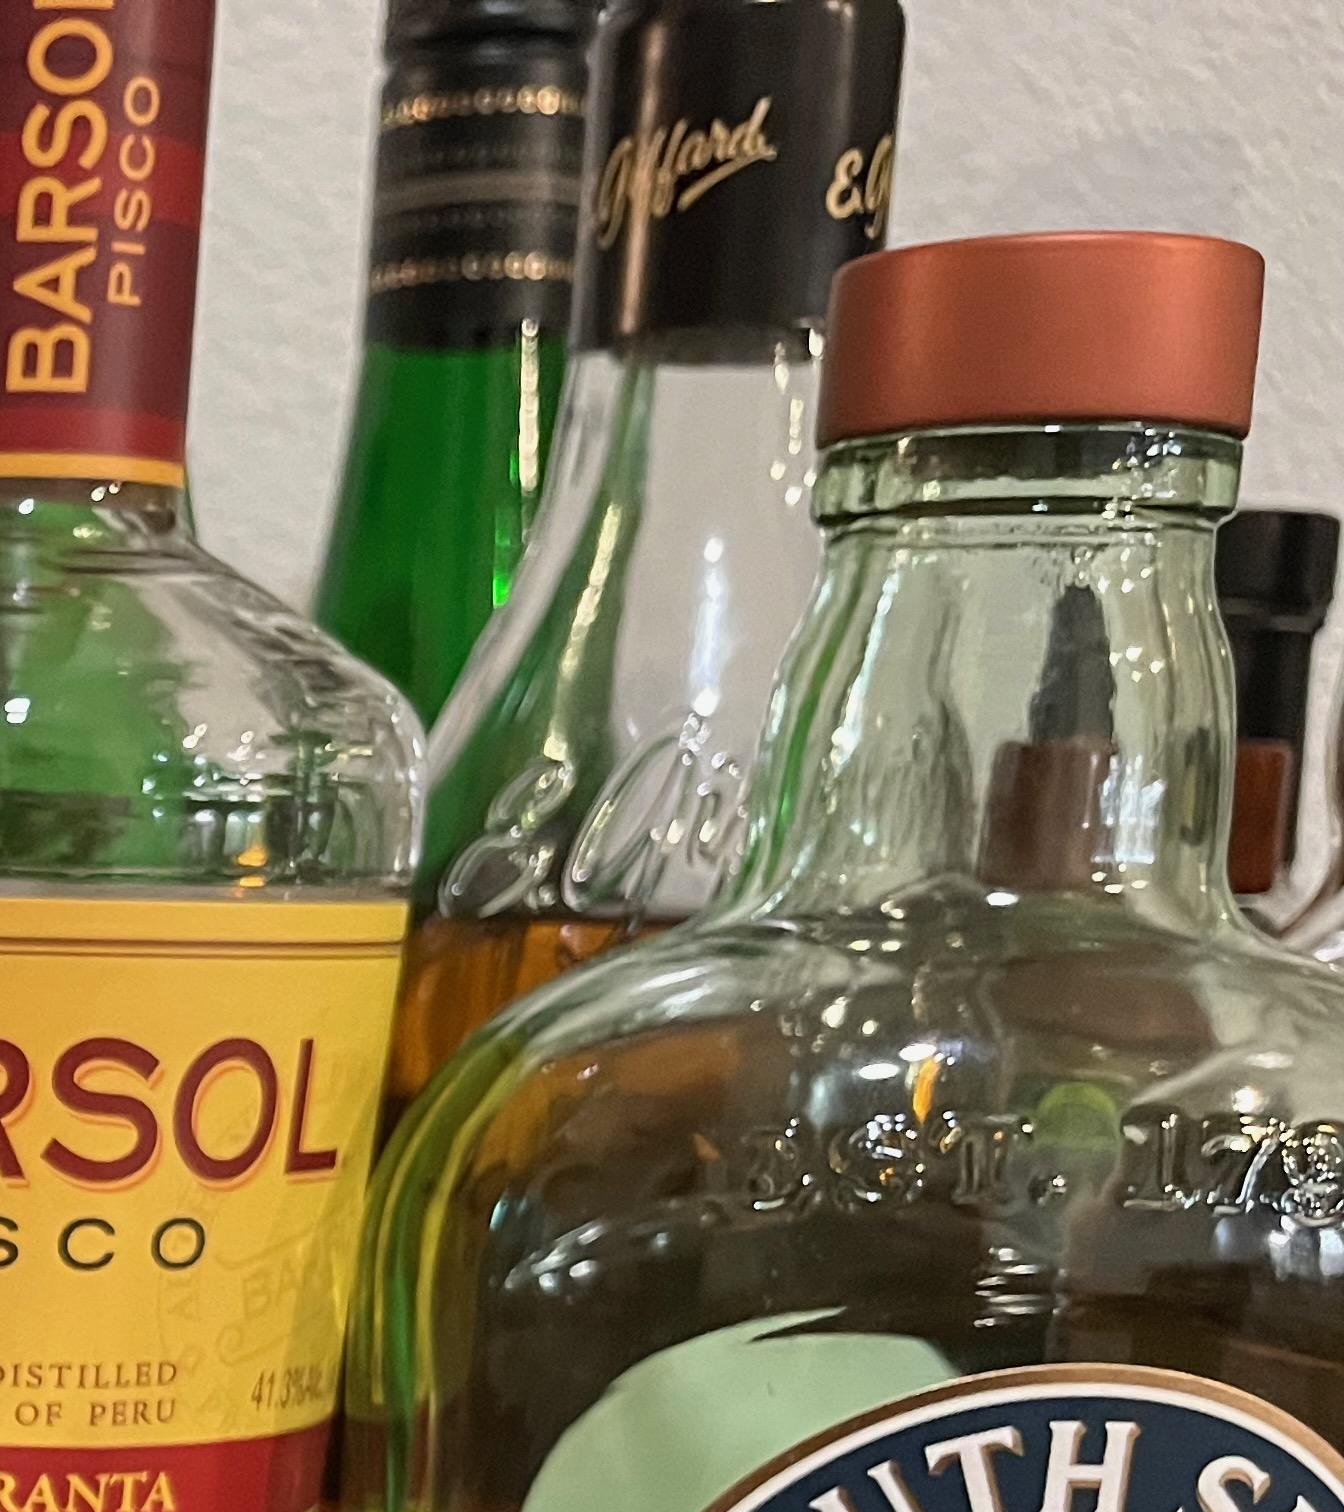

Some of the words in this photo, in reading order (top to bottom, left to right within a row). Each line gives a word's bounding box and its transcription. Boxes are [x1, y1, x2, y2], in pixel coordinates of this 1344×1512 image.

[108, 76, 161, 307] PISCO
[14, 1400, 63, 1427] OF
[88, 1397, 178, 1428] PERU
